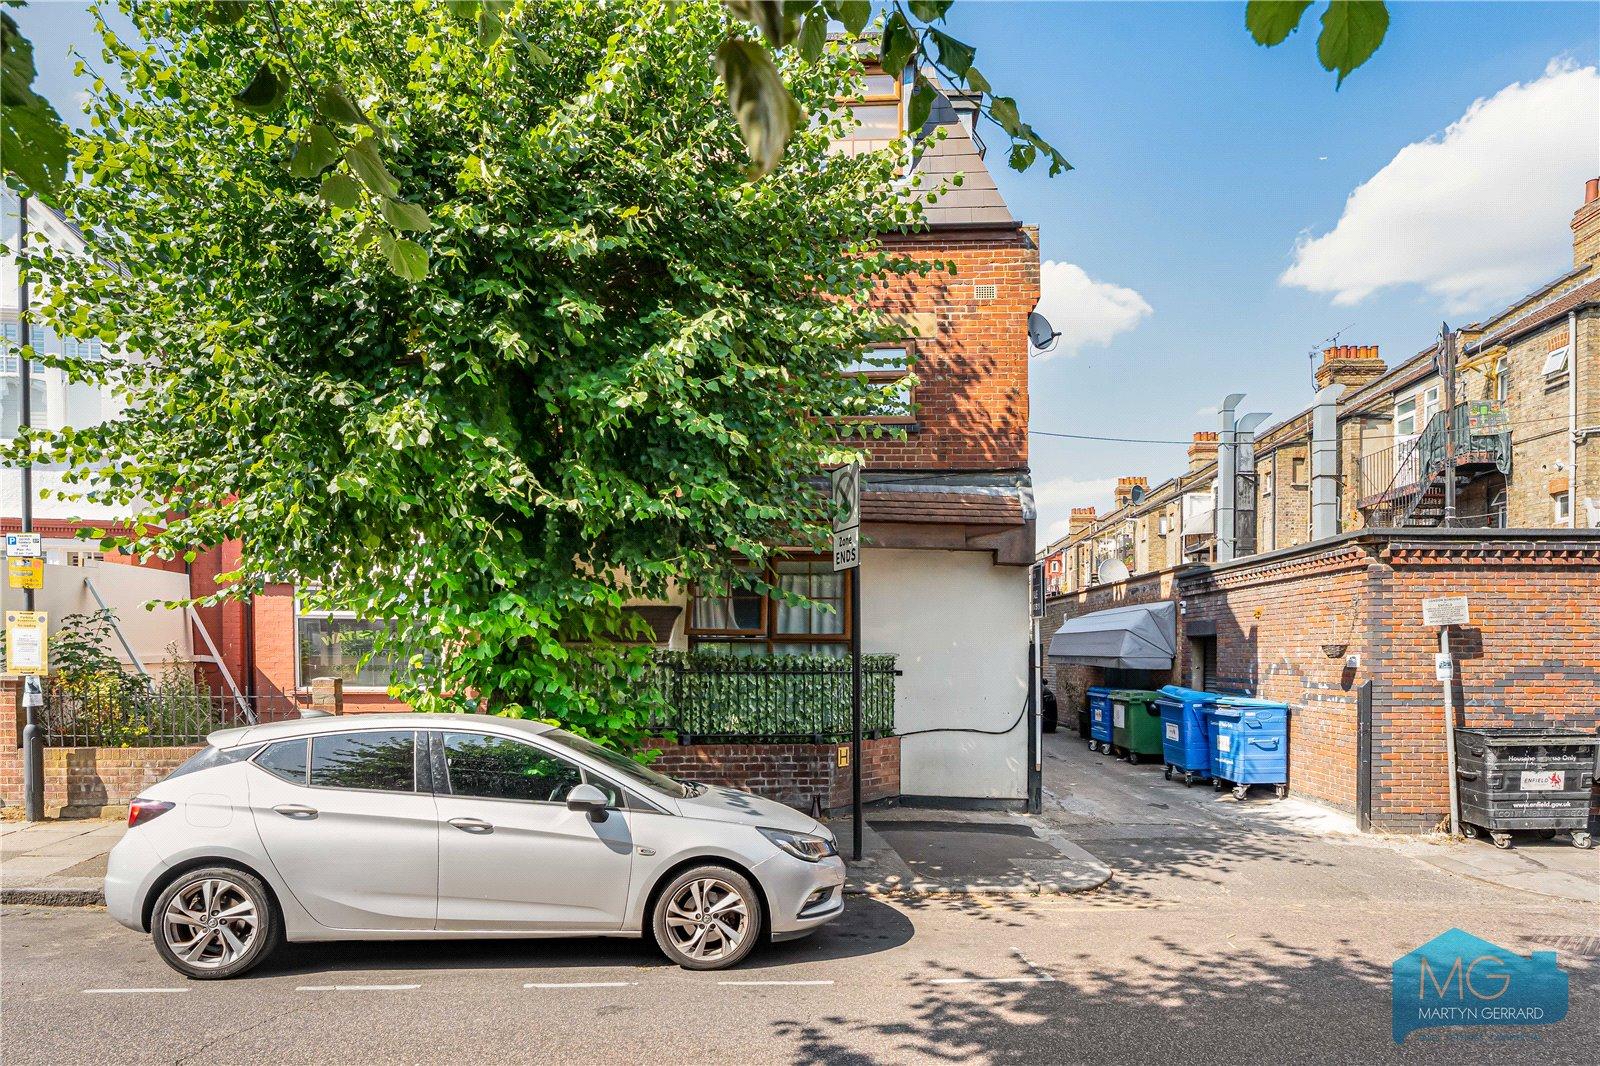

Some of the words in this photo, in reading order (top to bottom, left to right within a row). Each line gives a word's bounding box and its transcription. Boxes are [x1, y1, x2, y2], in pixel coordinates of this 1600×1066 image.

[839, 536, 852, 547] Zone
[836, 548, 856, 565] ENDS
[1562, 754, 1576, 762] Only
[1513, 801, 1571, 809] www.enfield.gov.uk
